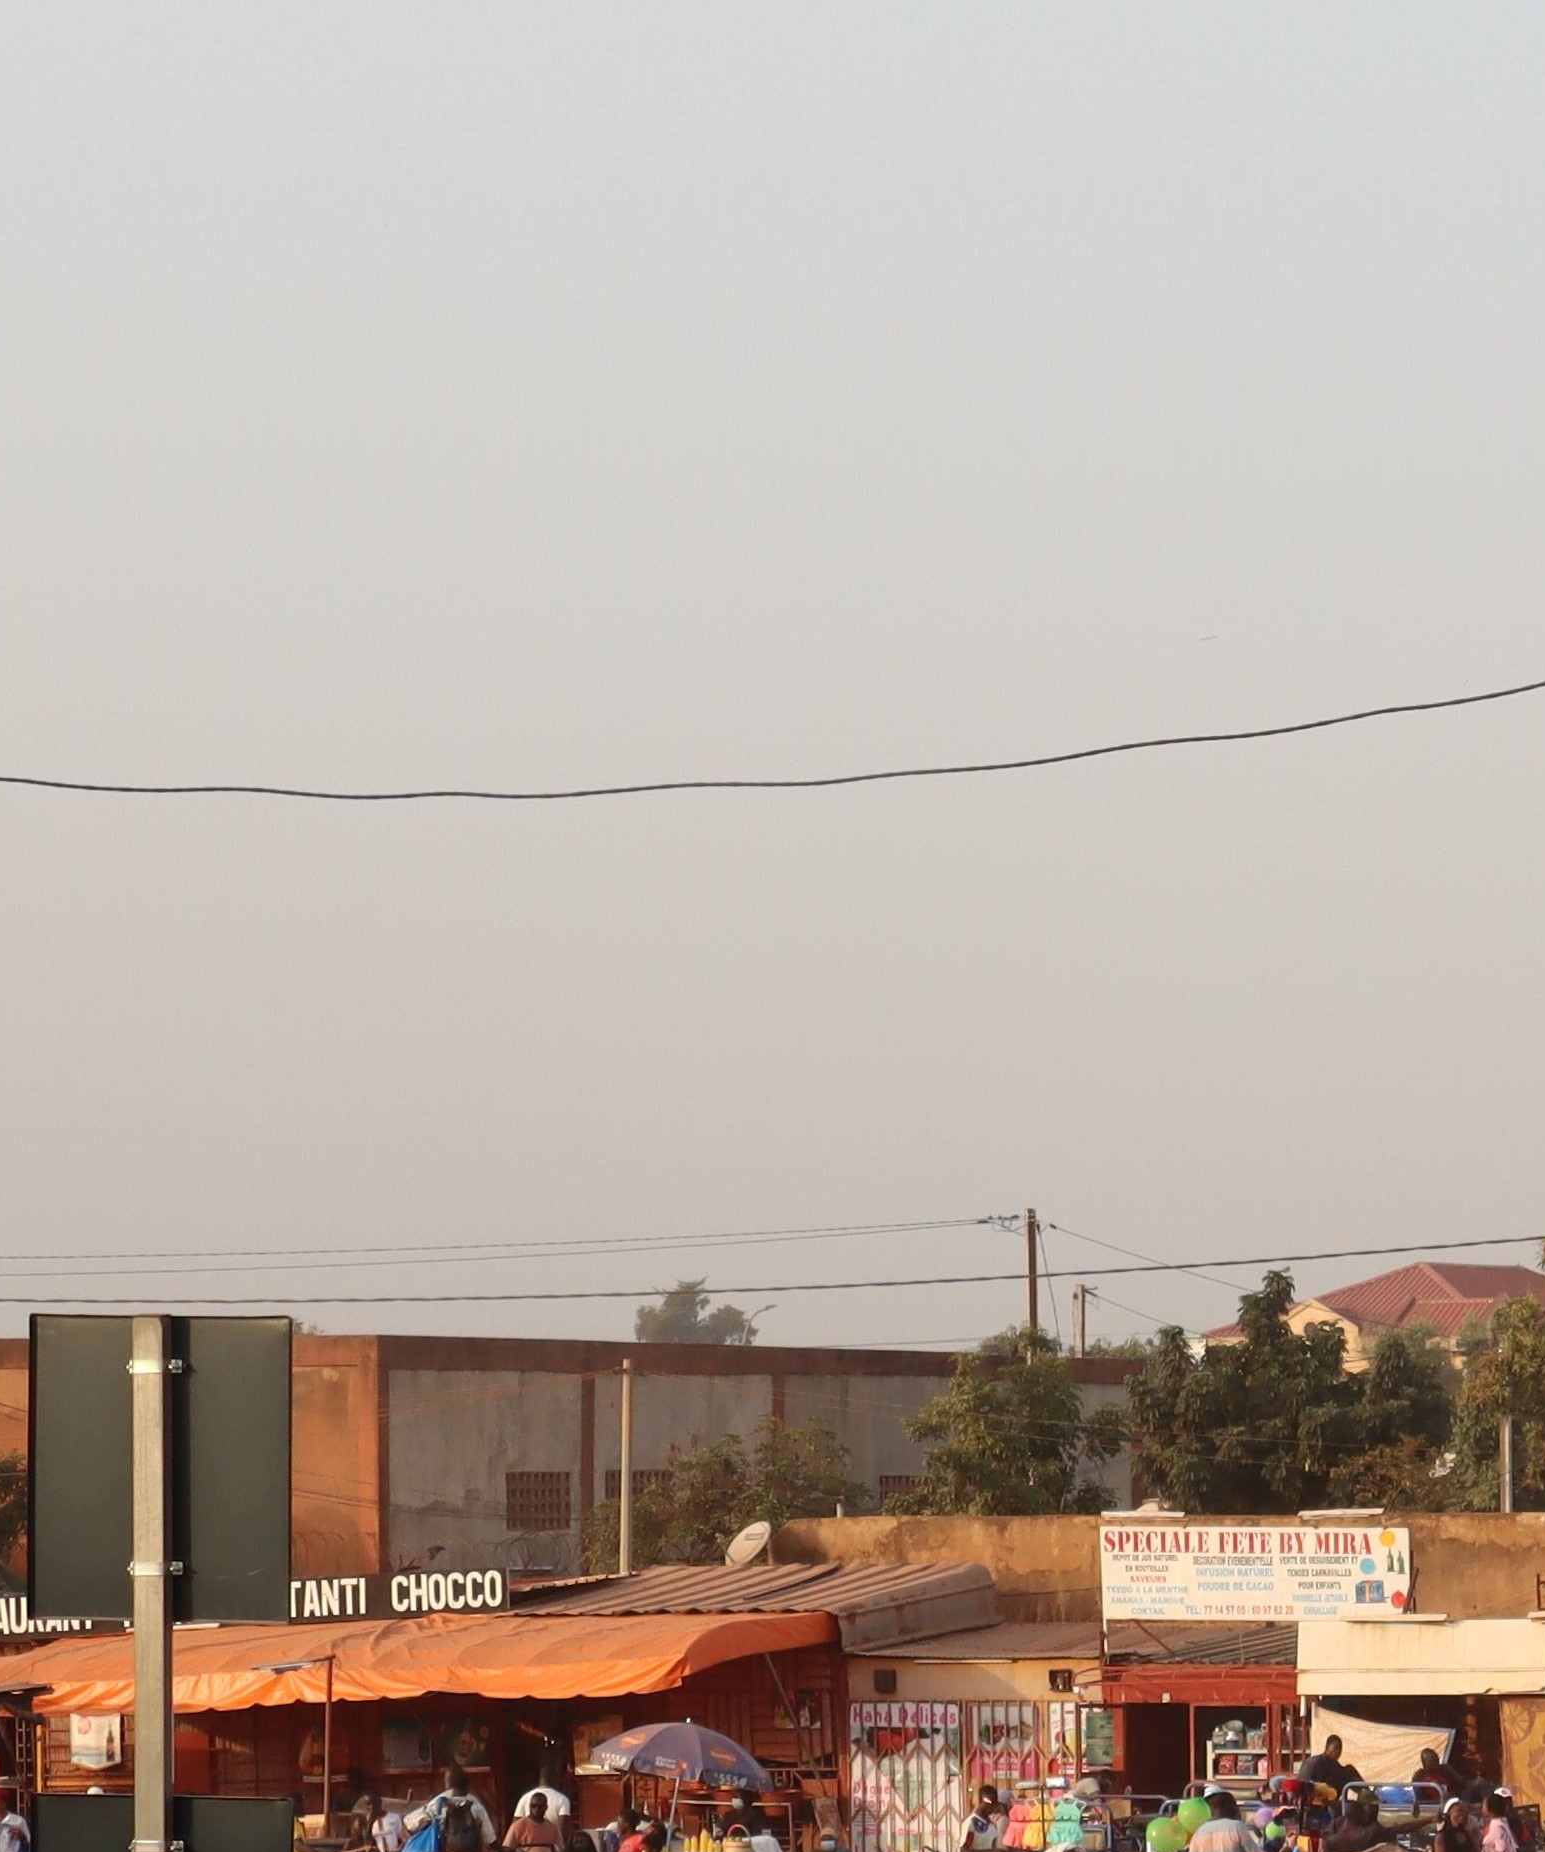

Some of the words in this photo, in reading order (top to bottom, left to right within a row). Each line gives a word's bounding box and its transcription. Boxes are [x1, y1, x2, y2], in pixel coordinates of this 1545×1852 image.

[1104, 1530, 1210, 1553] SPECIALE
[1218, 1532, 1272, 1554] FETE
[1279, 1532, 1306, 1555] BY
[1314, 1532, 1372, 1555] MIRA
[1195, 1567, 1235, 1577] INFUSION
[1237, 1567, 1275, 1577] NATUREL
[290, 1577, 367, 1618] TANTI
[391, 1570, 503, 1612] CHOCCO
[1233, 1582, 1244, 1591] DE
[1245, 1582, 1274, 1591] CACAO
